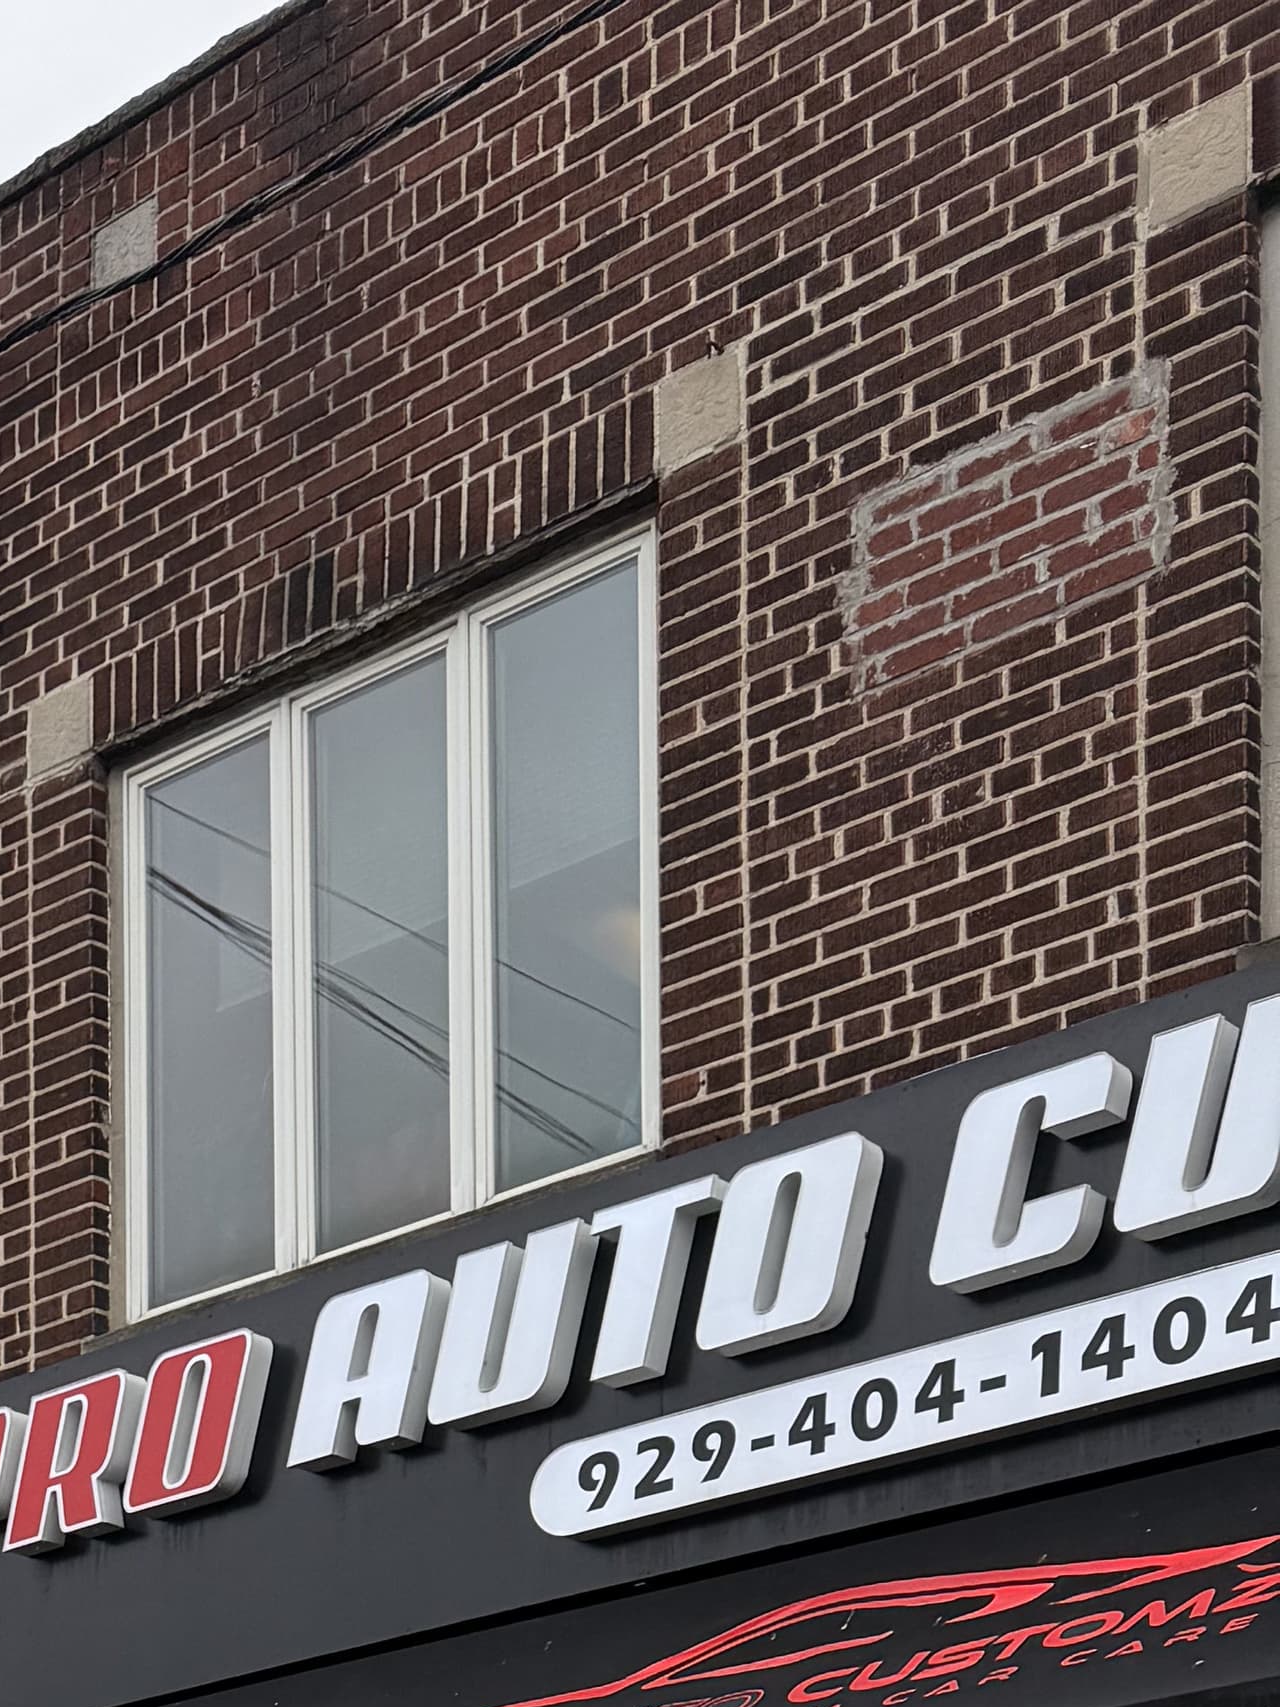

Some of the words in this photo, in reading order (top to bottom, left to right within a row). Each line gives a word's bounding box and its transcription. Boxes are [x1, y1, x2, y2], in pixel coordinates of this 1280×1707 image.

[287, 1131, 884, 1471] AUTO
[929, 992, 1280, 1294] CU
[577, 1276, 1280, 1512] 929-404-1404
[882, 1667, 1018, 1706] CAR
[1060, 1614, 1259, 1666] CARE
